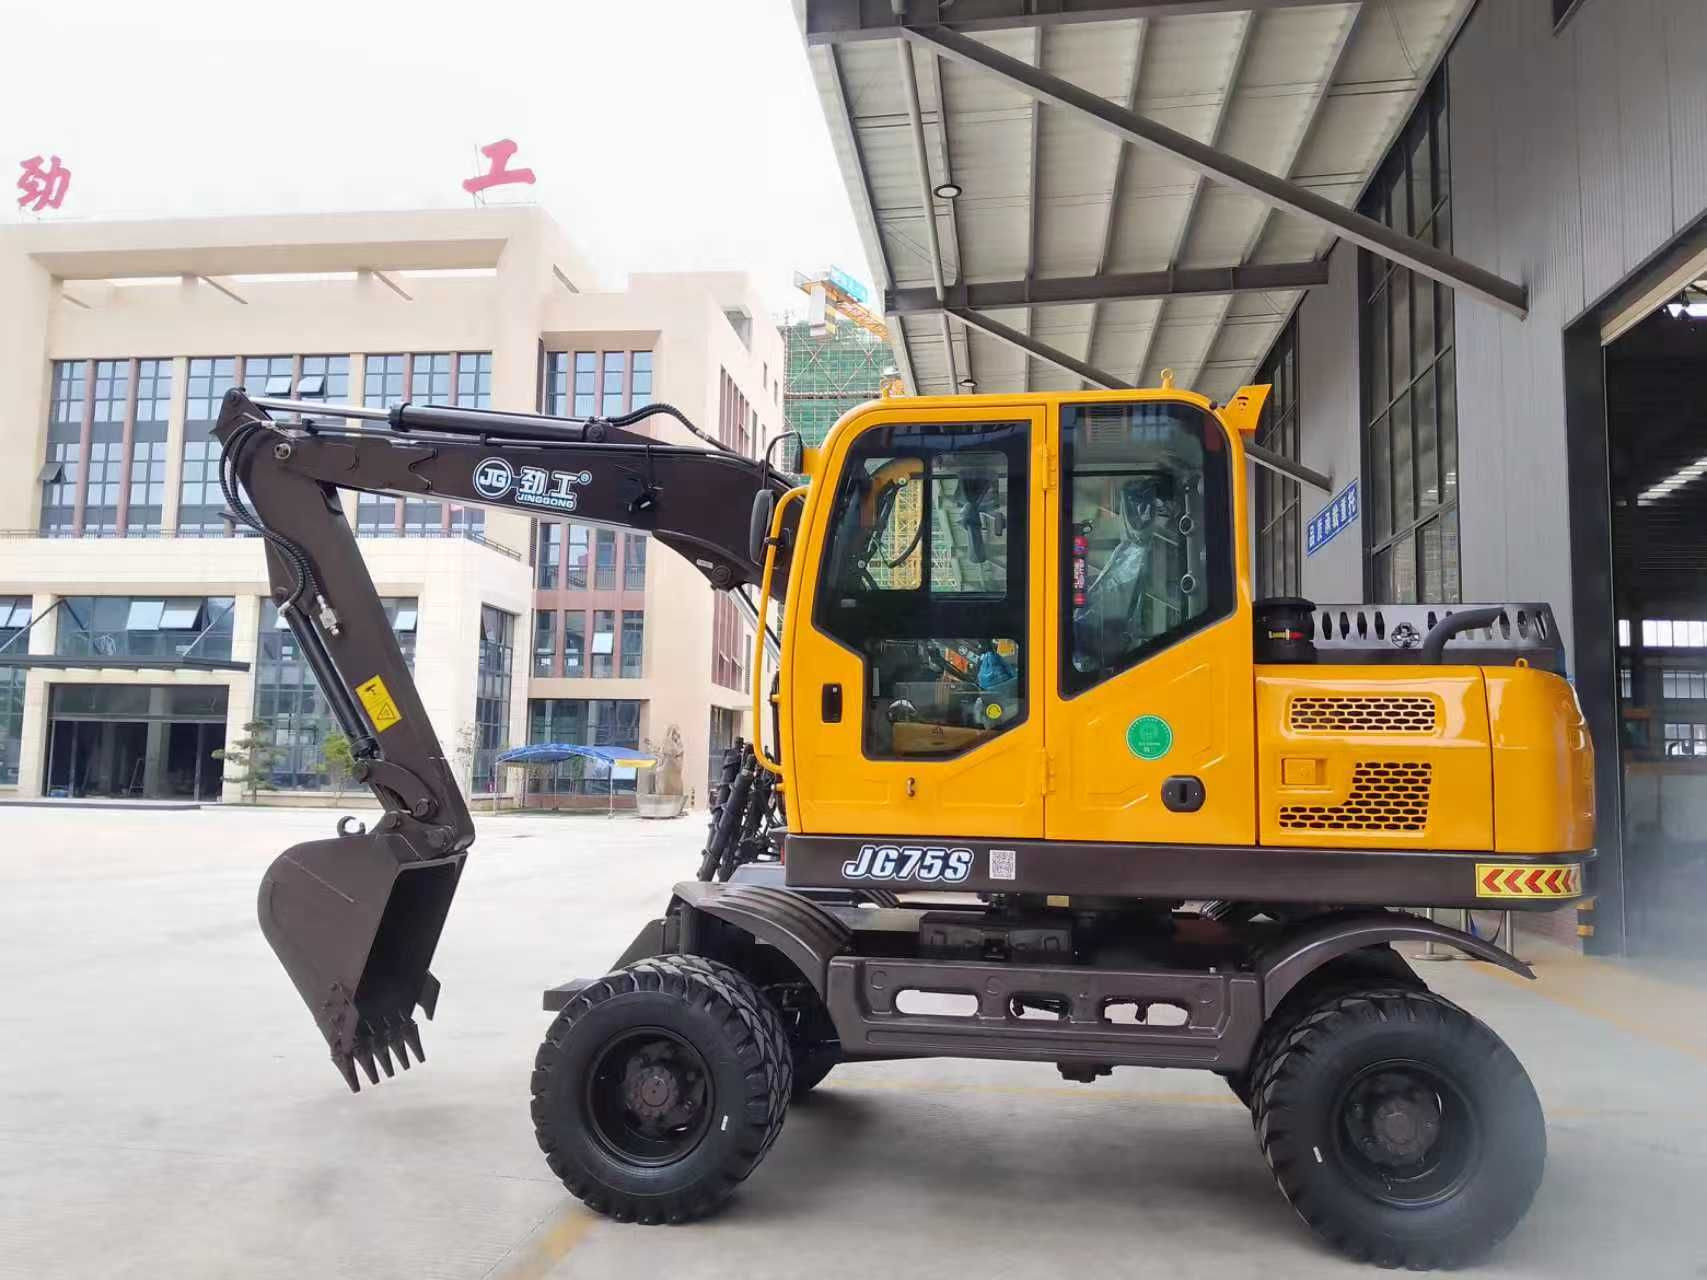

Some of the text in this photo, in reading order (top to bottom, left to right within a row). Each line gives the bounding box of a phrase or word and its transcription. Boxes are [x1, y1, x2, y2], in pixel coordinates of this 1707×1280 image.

[16, 138, 536, 211] 劲 工
[479, 467, 508, 488] JG
[519, 468, 578, 500] 劲工
[843, 846, 972, 880] JG75S
